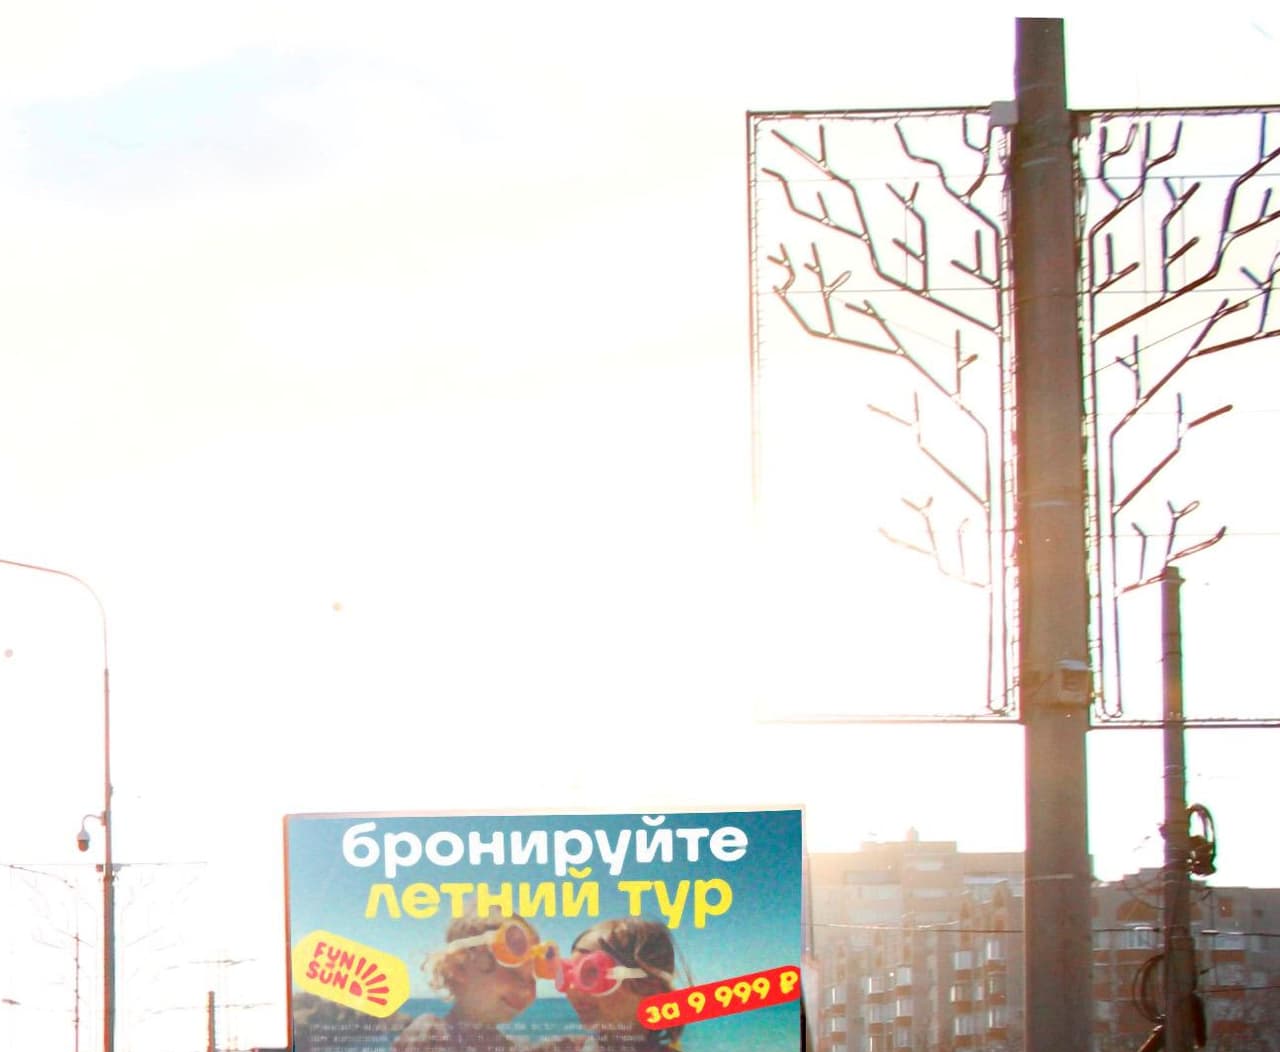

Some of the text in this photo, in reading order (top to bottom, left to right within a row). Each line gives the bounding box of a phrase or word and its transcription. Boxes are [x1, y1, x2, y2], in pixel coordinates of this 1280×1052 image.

[341, 814, 749, 878] бронируйте
[364, 866, 734, 930] летний тур
[305, 959, 349, 990] SUN
[313, 941, 356, 971] FUN
[644, 1001, 681, 1024] за
[686, 991, 707, 1015] 9
[713, 976, 771, 1008] 999
